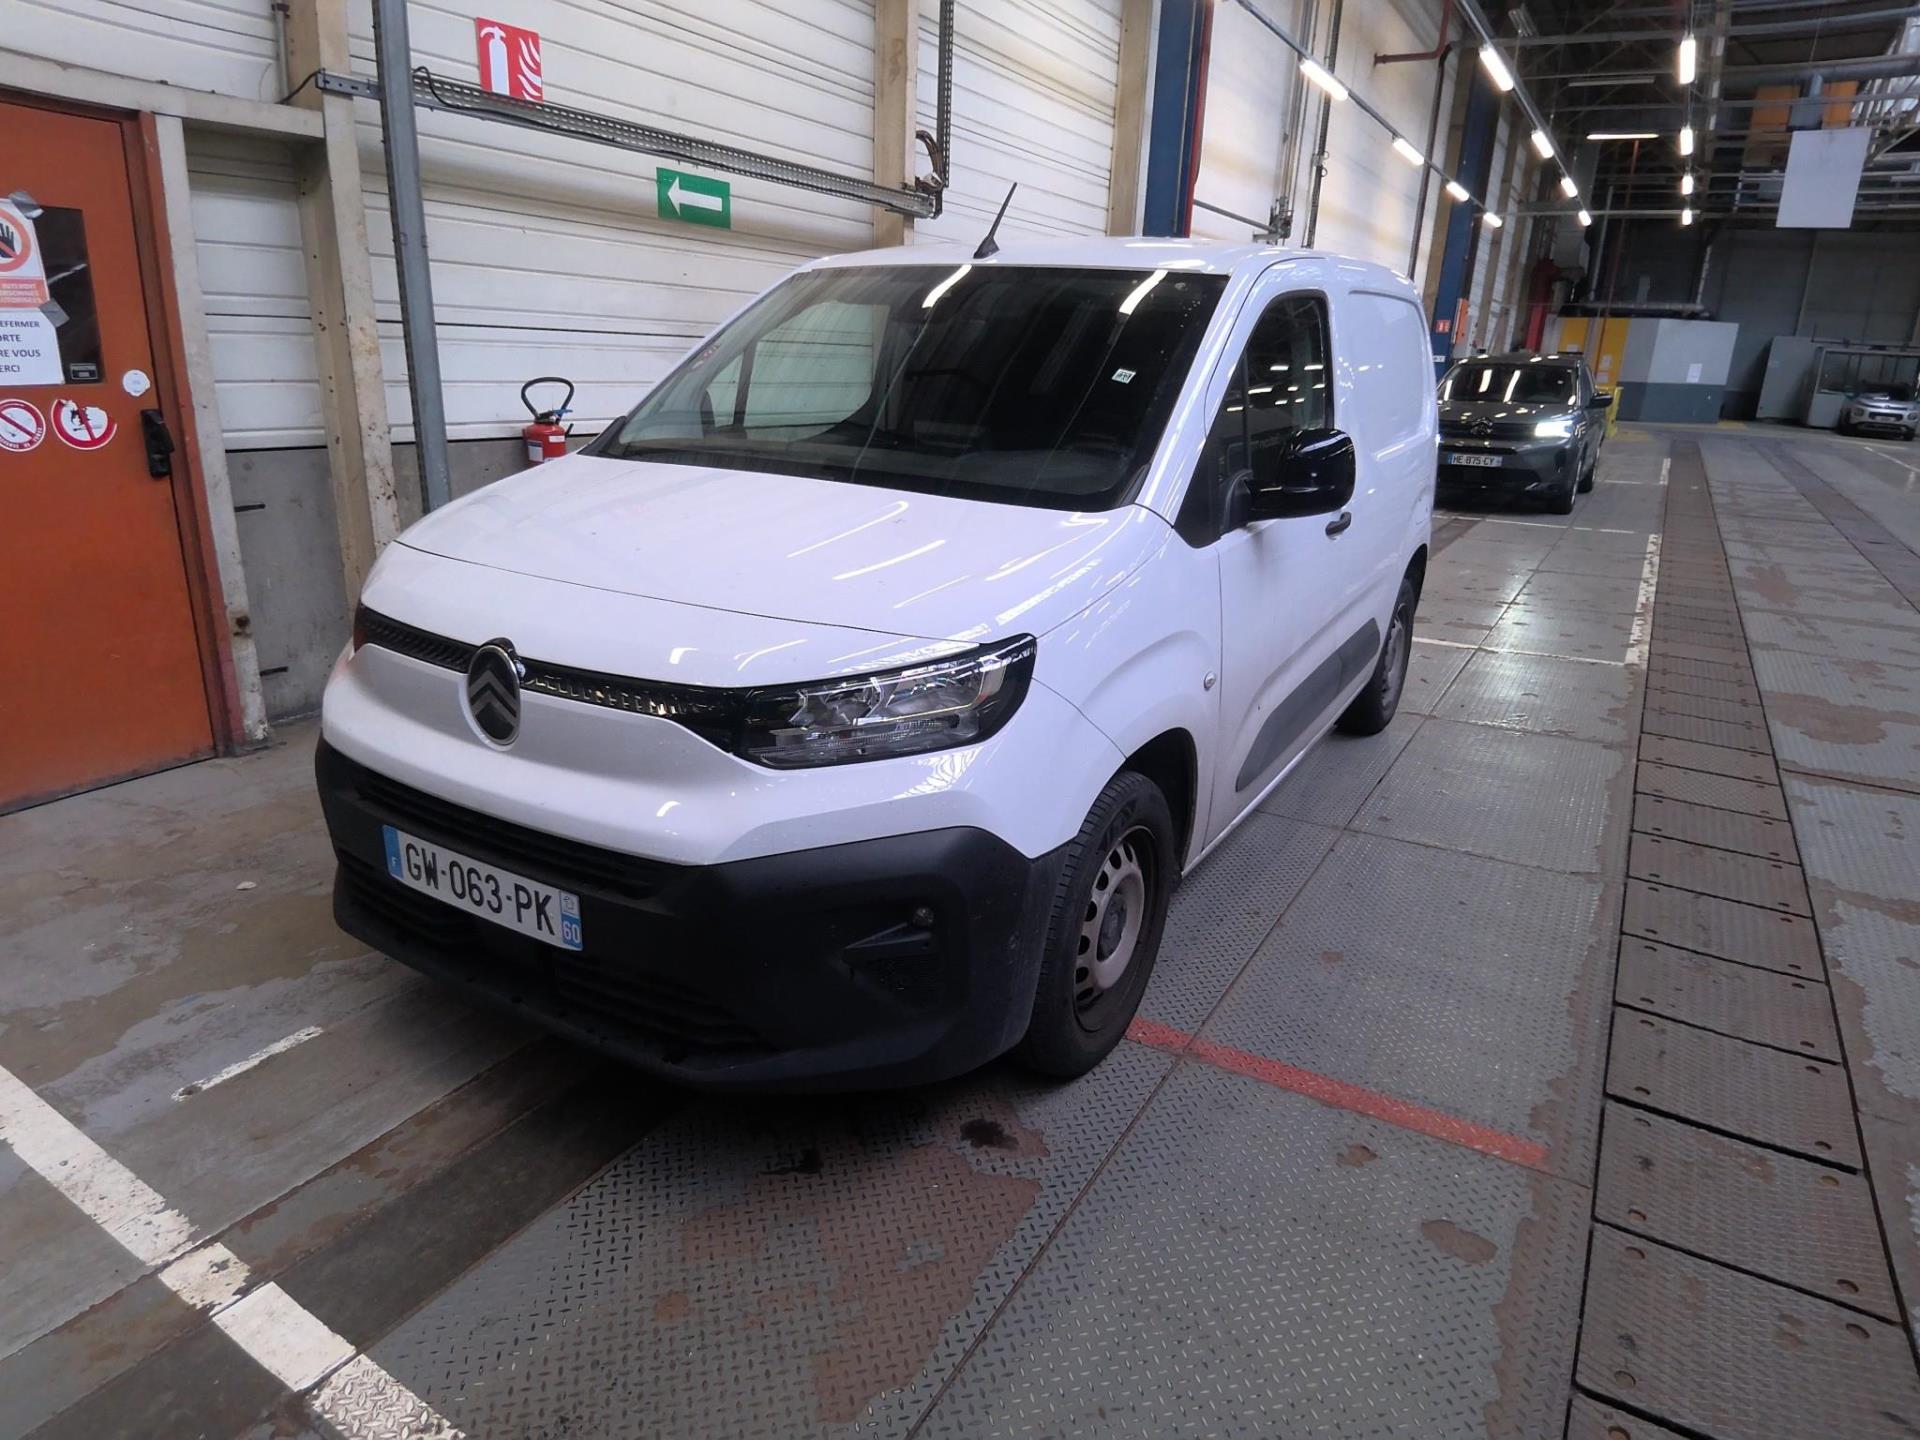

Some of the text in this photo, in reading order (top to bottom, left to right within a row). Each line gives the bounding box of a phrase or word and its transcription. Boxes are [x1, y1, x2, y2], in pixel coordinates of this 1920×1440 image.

[11, 349, 41, 358] VOUS
[405, 842, 555, 936] GW-063-PK
[562, 920, 581, 944] 60
